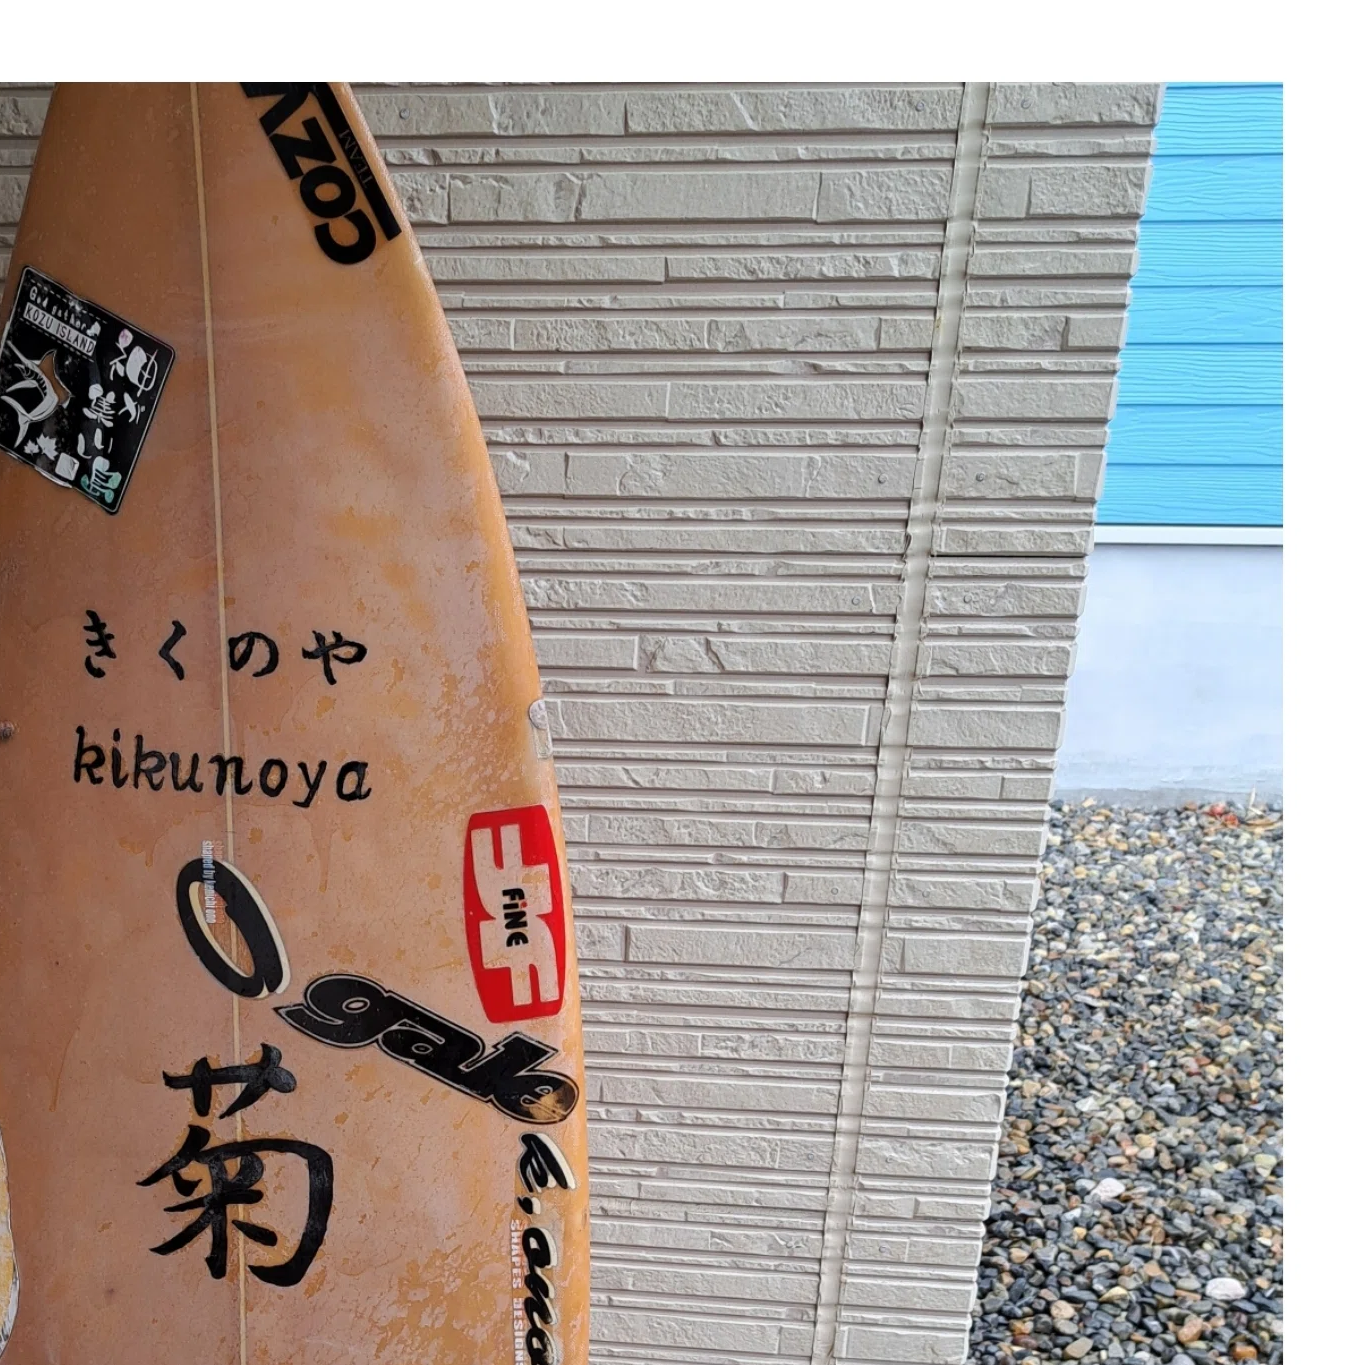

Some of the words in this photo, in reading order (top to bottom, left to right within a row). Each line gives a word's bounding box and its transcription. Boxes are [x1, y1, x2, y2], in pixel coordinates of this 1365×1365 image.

[338, 128, 373, 188] TEAM
[25, 304, 54, 330] KOZU
[55, 322, 96, 354] ISLAND
[82, 609, 368, 685] きくのや
[73, 725, 373, 808] kikunoya
[510, 1219, 524, 1289] SHAPES
